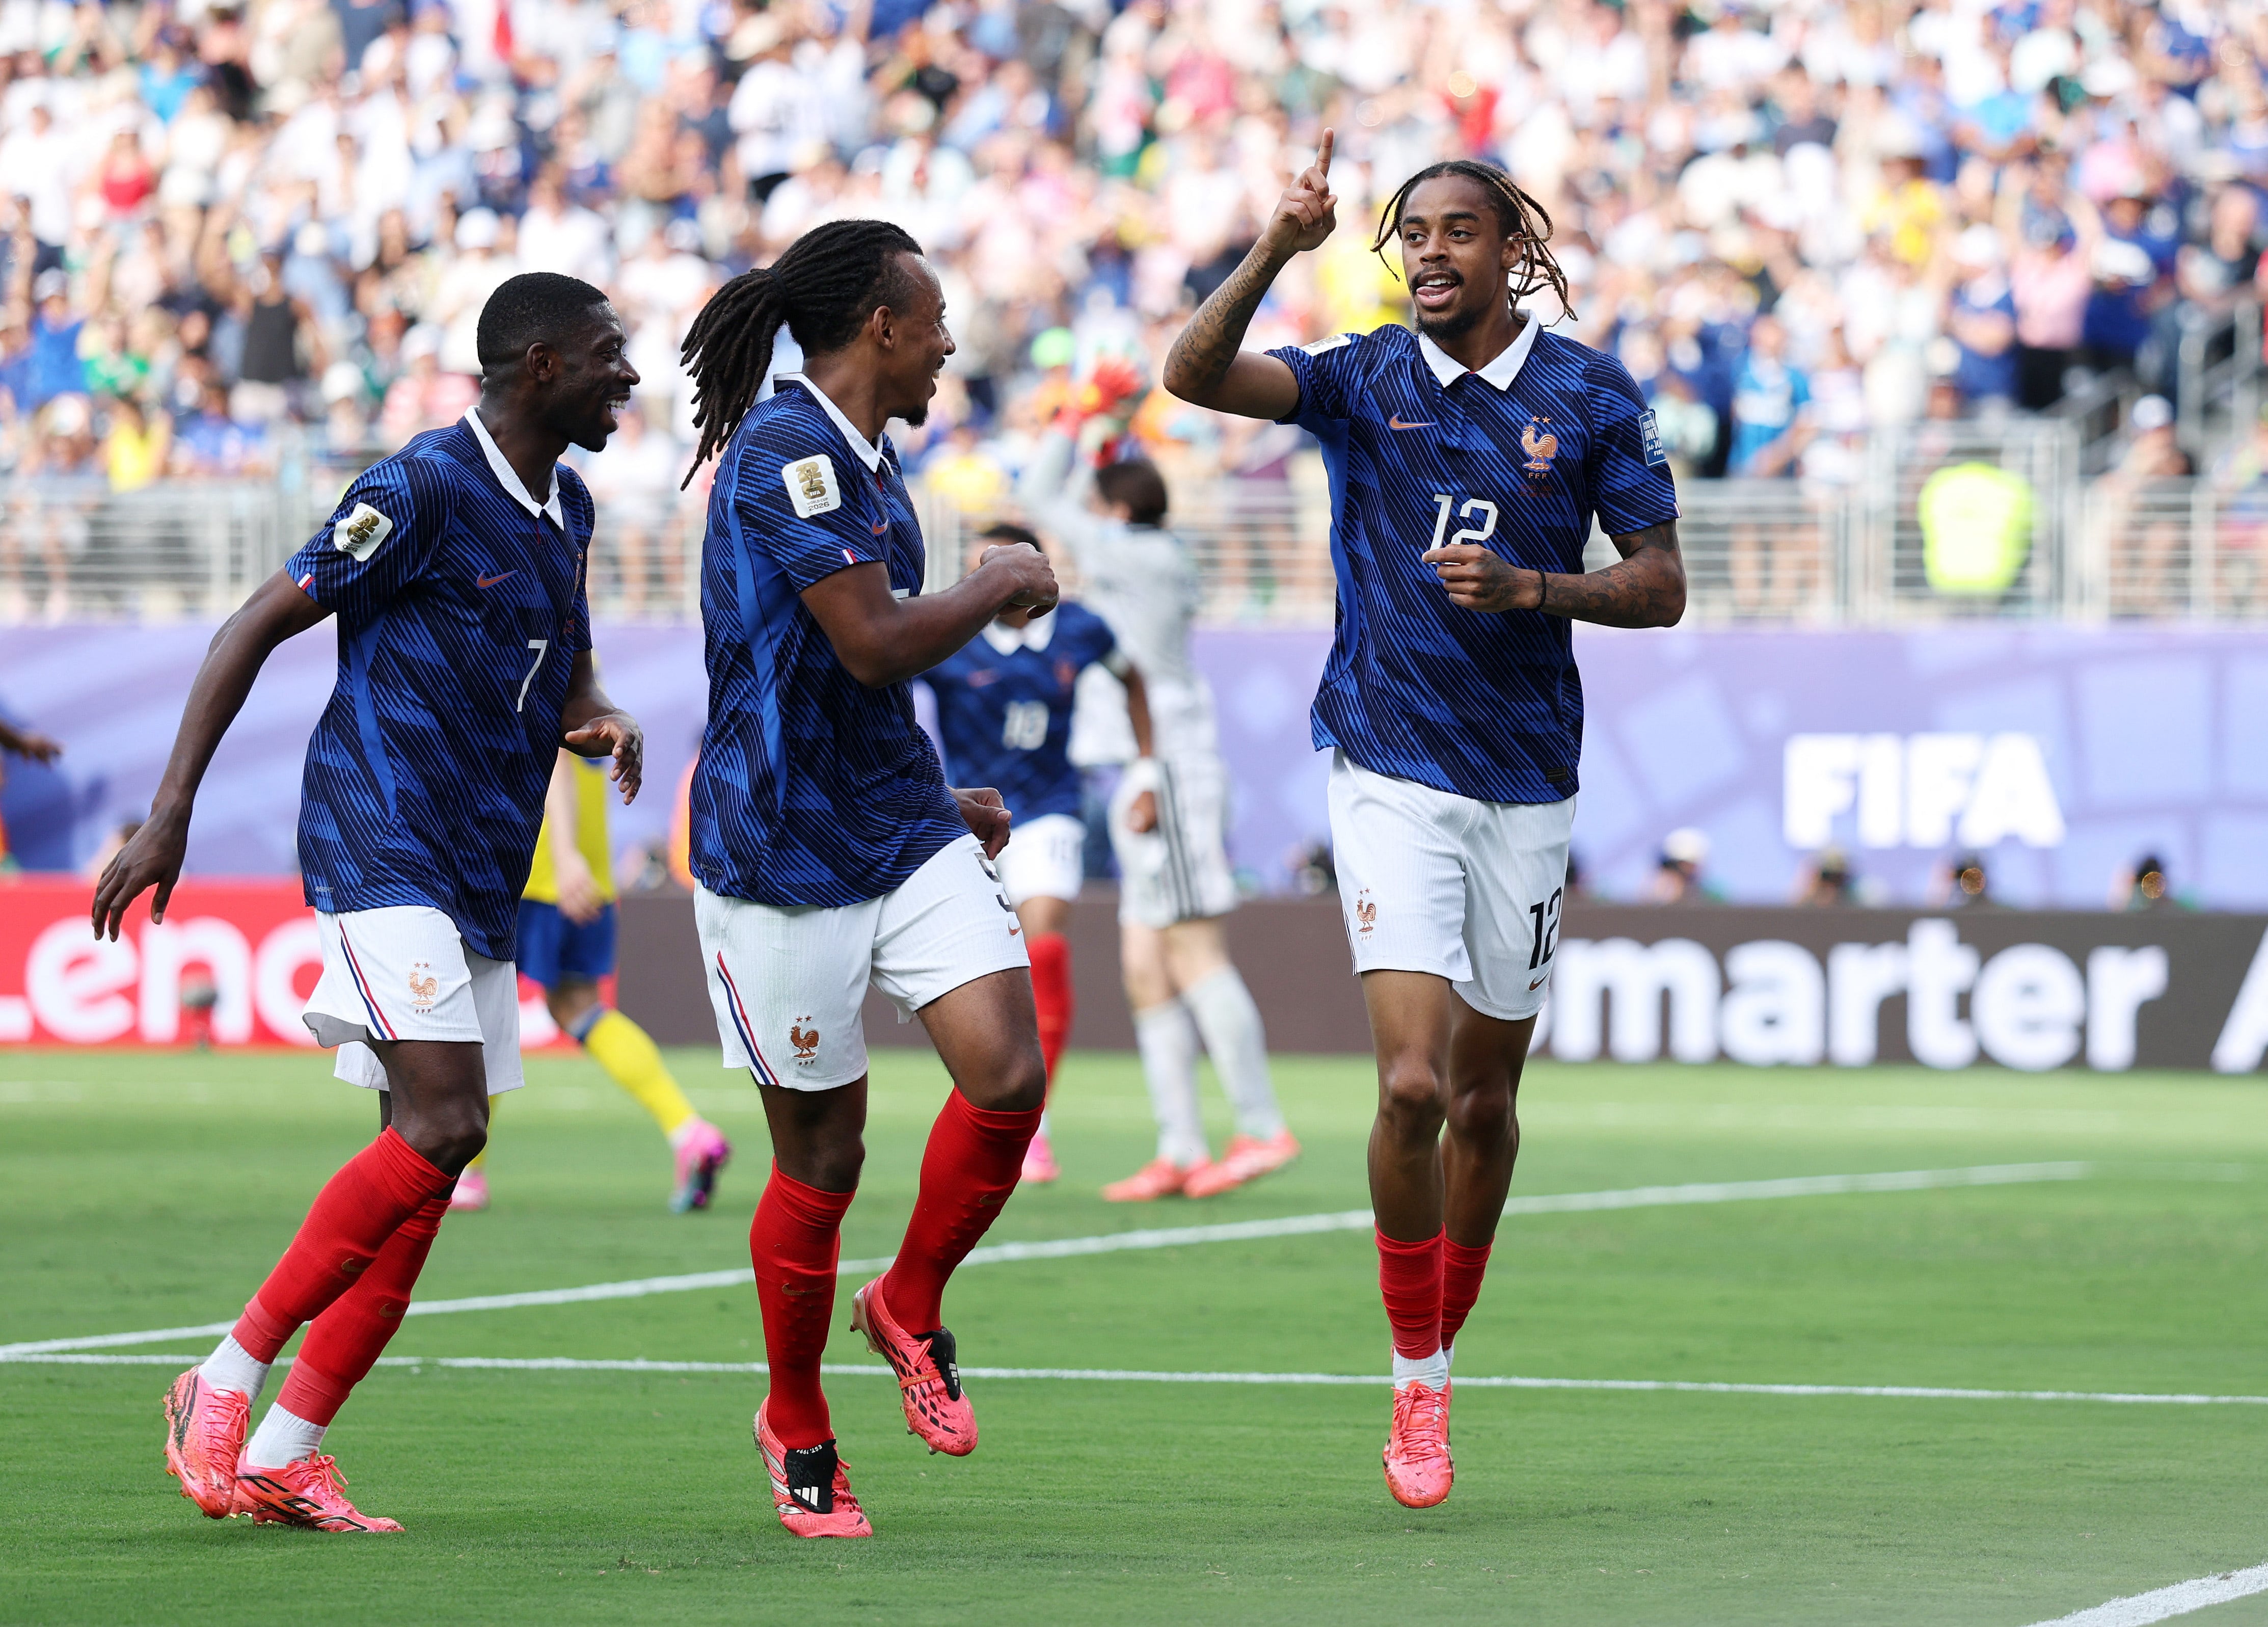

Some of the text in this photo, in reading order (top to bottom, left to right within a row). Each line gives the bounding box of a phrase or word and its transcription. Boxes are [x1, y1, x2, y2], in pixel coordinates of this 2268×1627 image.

[1643, 419, 1656, 430] FOOT
[1644, 426, 1659, 441] UNIT
[350, 534, 360, 542] FIFA
[808, 501, 829, 511] 2026
[1430, 494, 1499, 566] 12
[517, 639, 548, 712] 7
[1785, 732, 2066, 848] FIFA
[1528, 886, 1562, 970] 12
[1528, 919, 2170, 1072] marter
